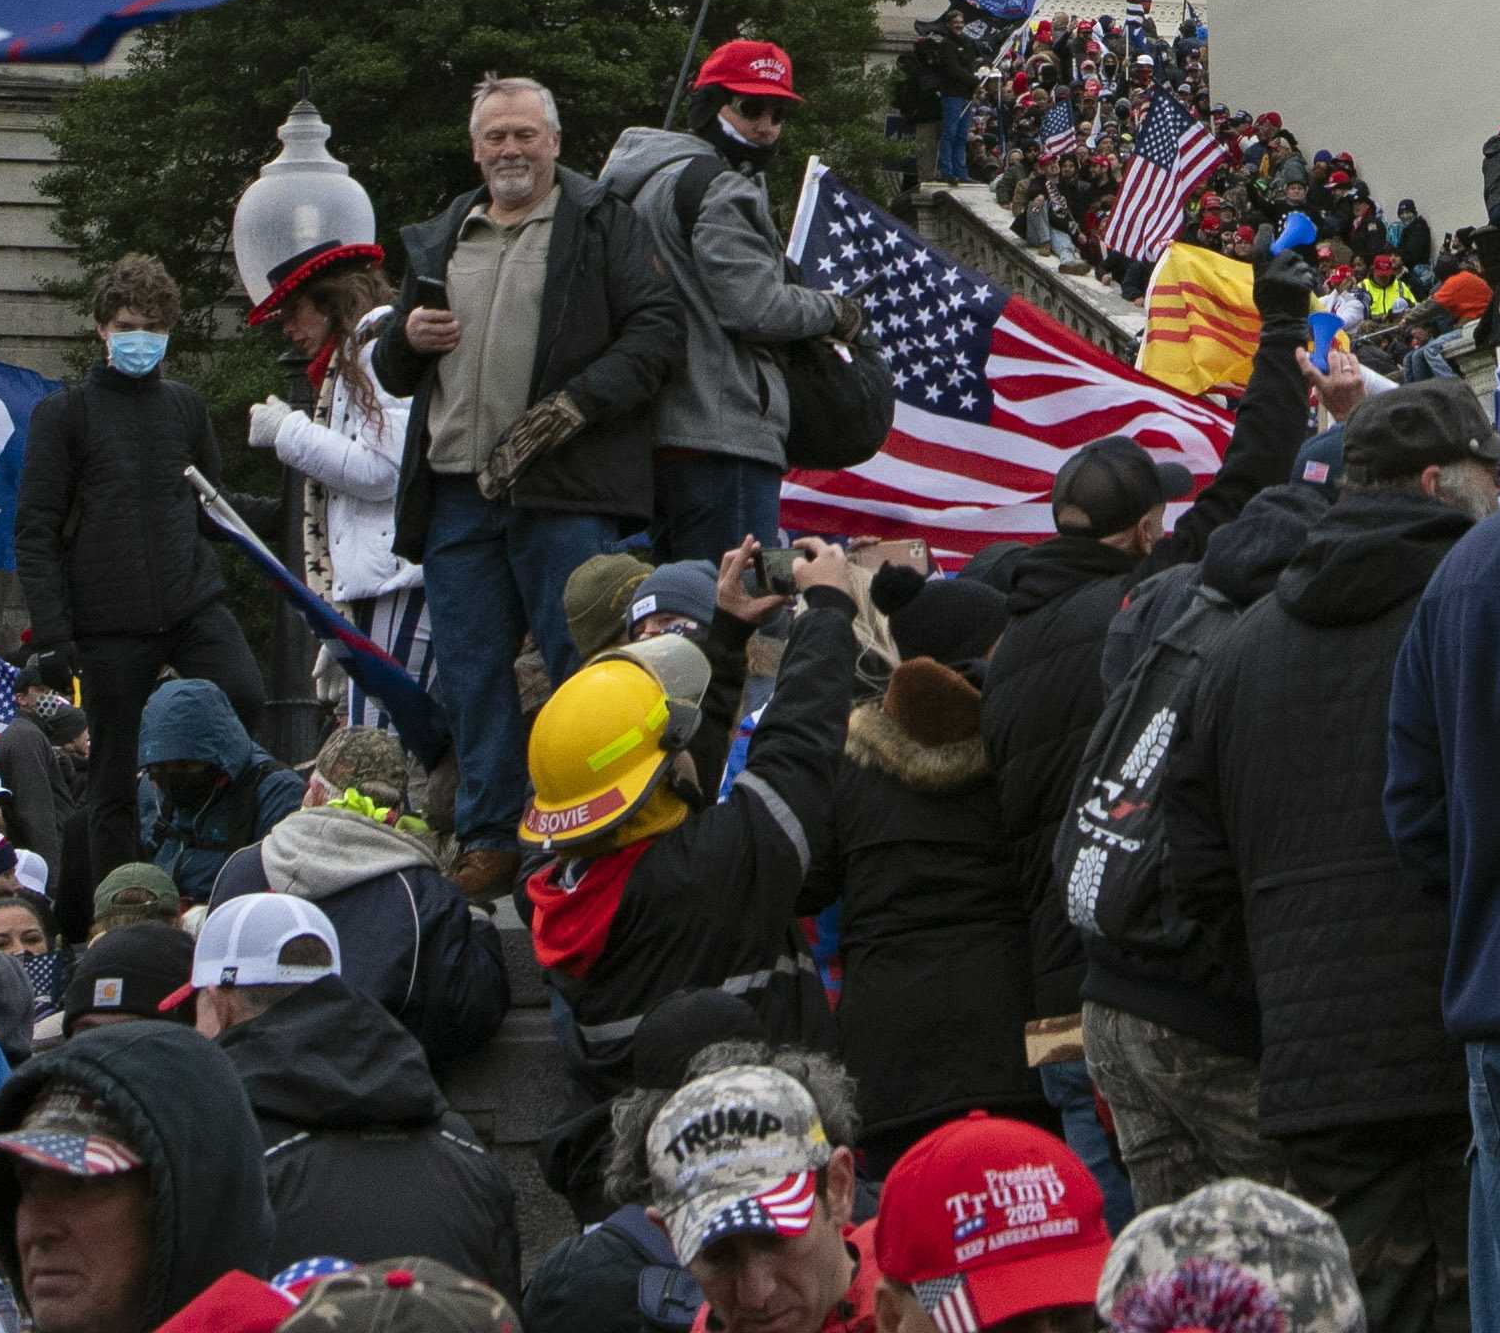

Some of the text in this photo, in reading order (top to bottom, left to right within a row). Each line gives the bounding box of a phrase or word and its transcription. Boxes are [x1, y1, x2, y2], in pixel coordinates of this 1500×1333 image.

[750, 58, 786, 74] TRUMP
[538, 803, 590, 833] SOVIE
[665, 1108, 782, 1164] TRUMP
[984, 1163, 1058, 1190] President
[946, 1178, 1066, 1224] Trump
[1005, 1201, 1048, 1228] 2020
[955, 1216, 1080, 1264] KEEP AMERICA GREAT!
